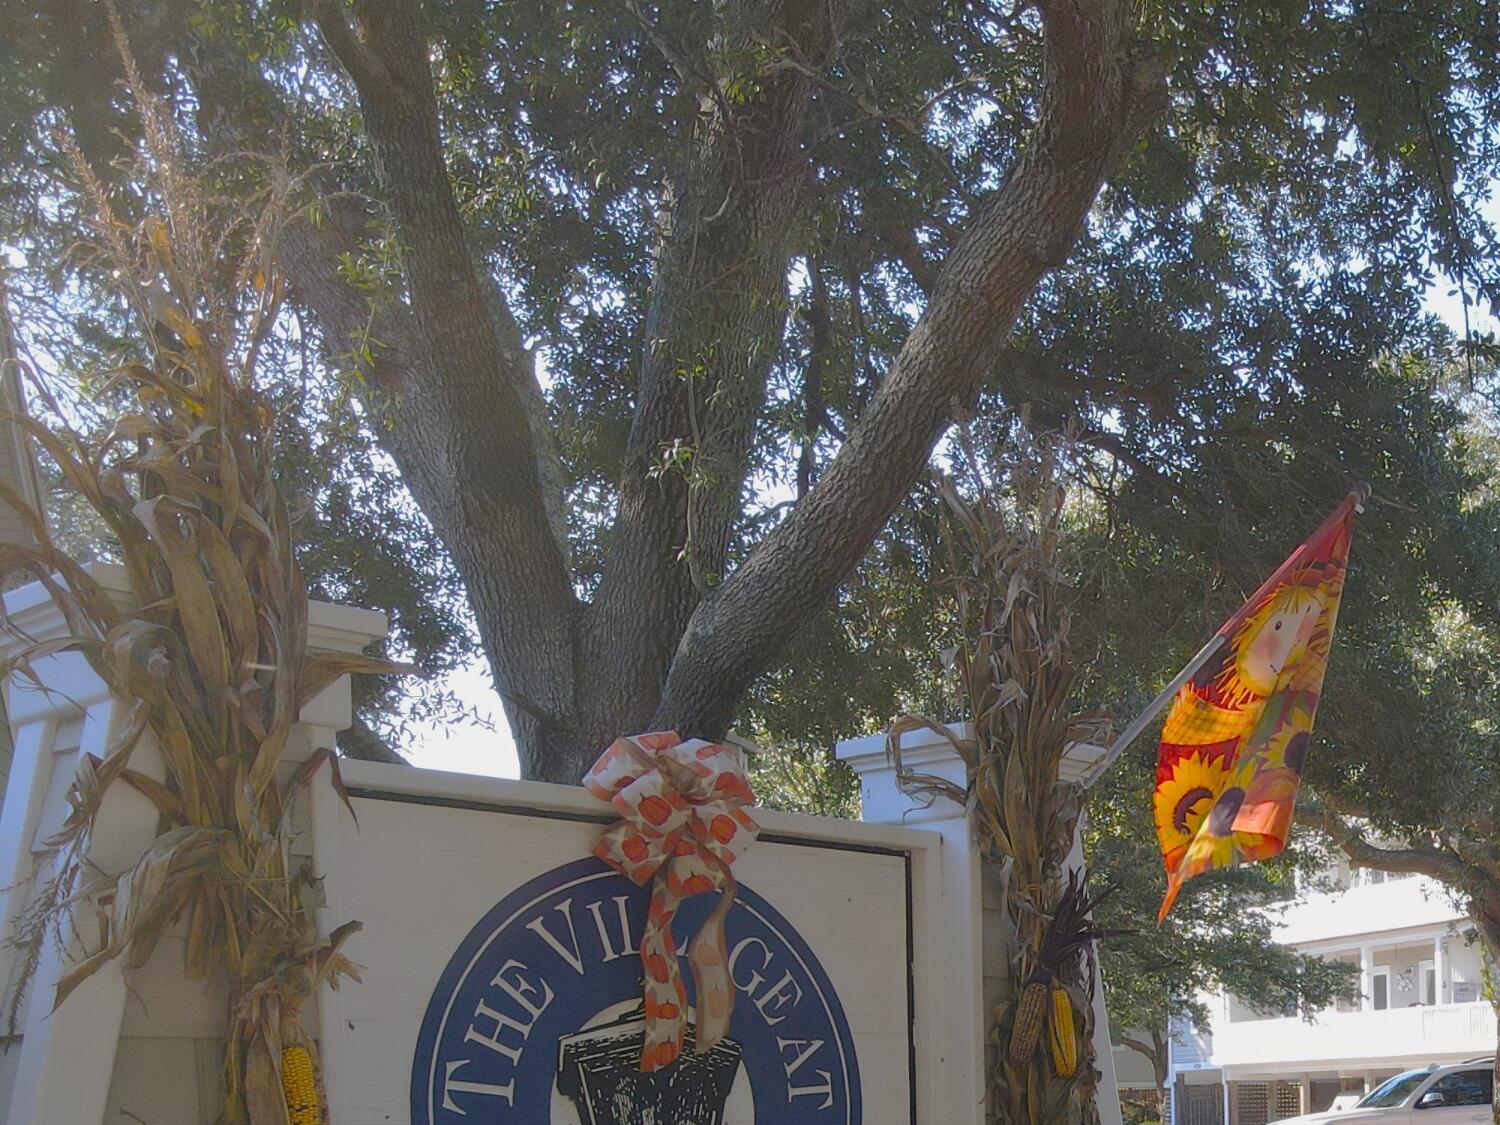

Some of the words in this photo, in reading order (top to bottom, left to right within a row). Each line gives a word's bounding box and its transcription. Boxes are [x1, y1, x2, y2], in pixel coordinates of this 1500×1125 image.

[442, 958, 556, 1115] THE
[525, 895, 803, 1026] VILGE
[776, 1035, 833, 1110] AT
